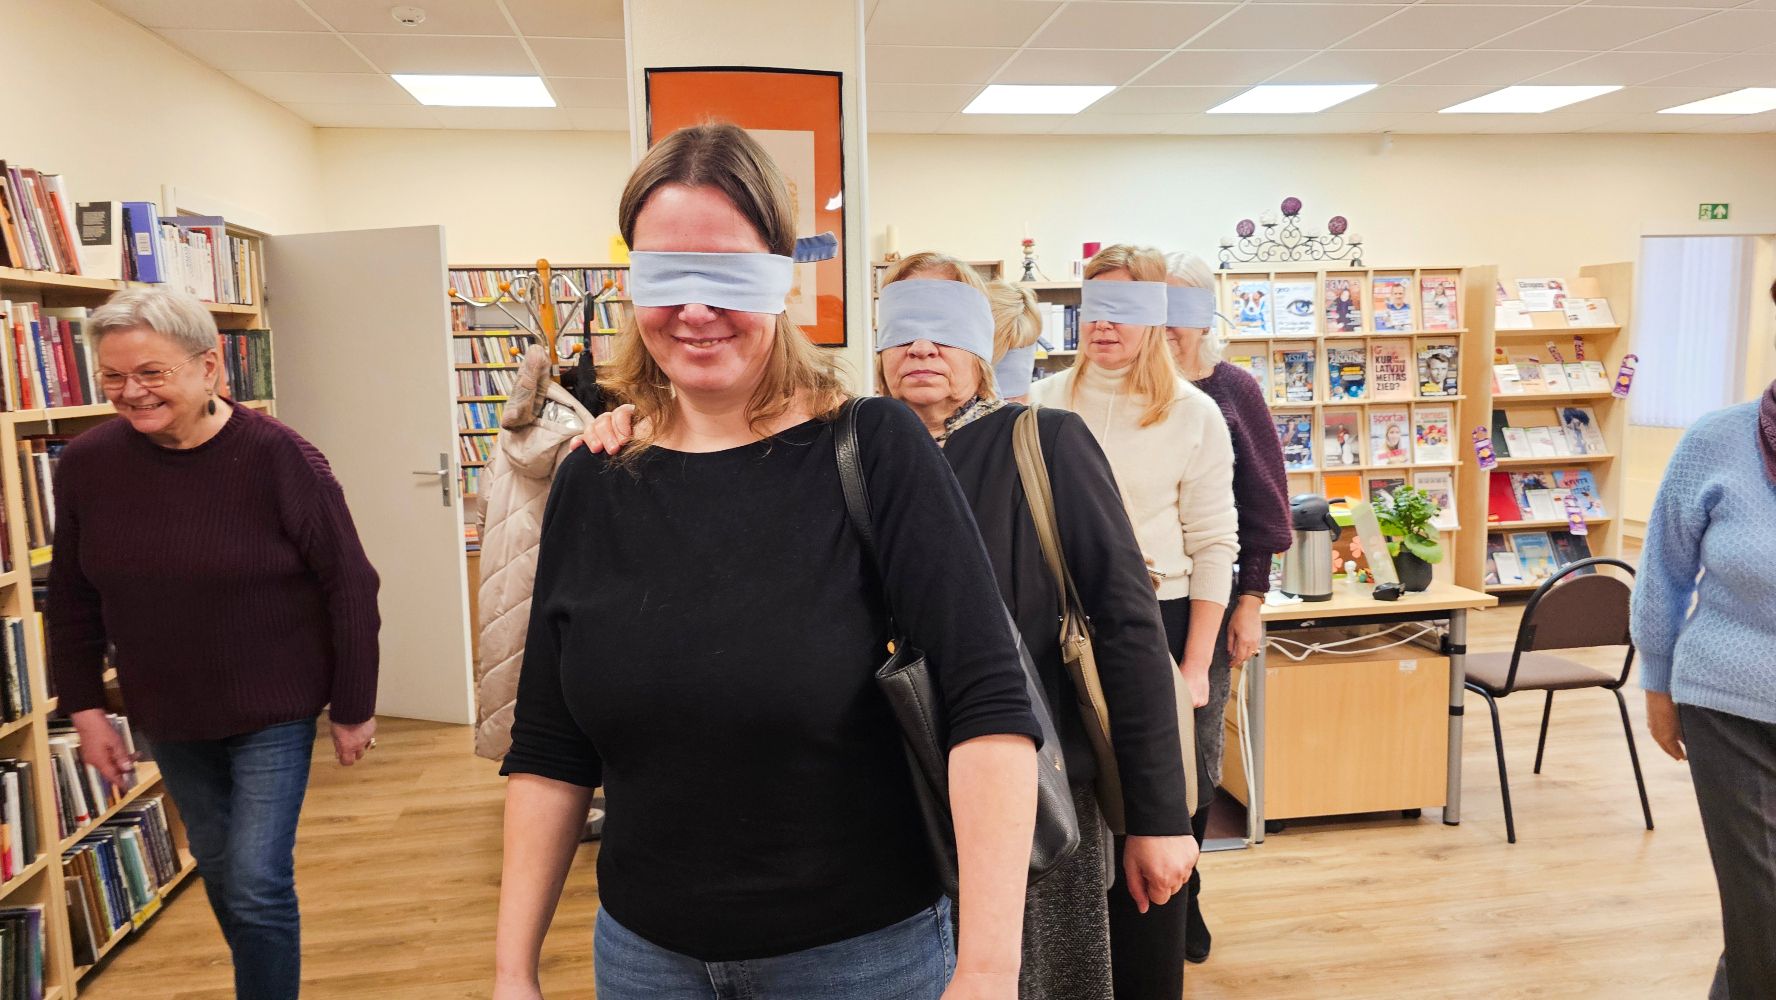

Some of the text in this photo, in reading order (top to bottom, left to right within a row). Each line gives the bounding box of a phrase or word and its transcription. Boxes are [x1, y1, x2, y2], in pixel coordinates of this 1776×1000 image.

[1375, 355, 1392, 364] KUR
[1375, 364, 1406, 373] LATVJU
[1376, 373, 1407, 382] MEITAS
[1376, 382, 1400, 391] ZIED?
